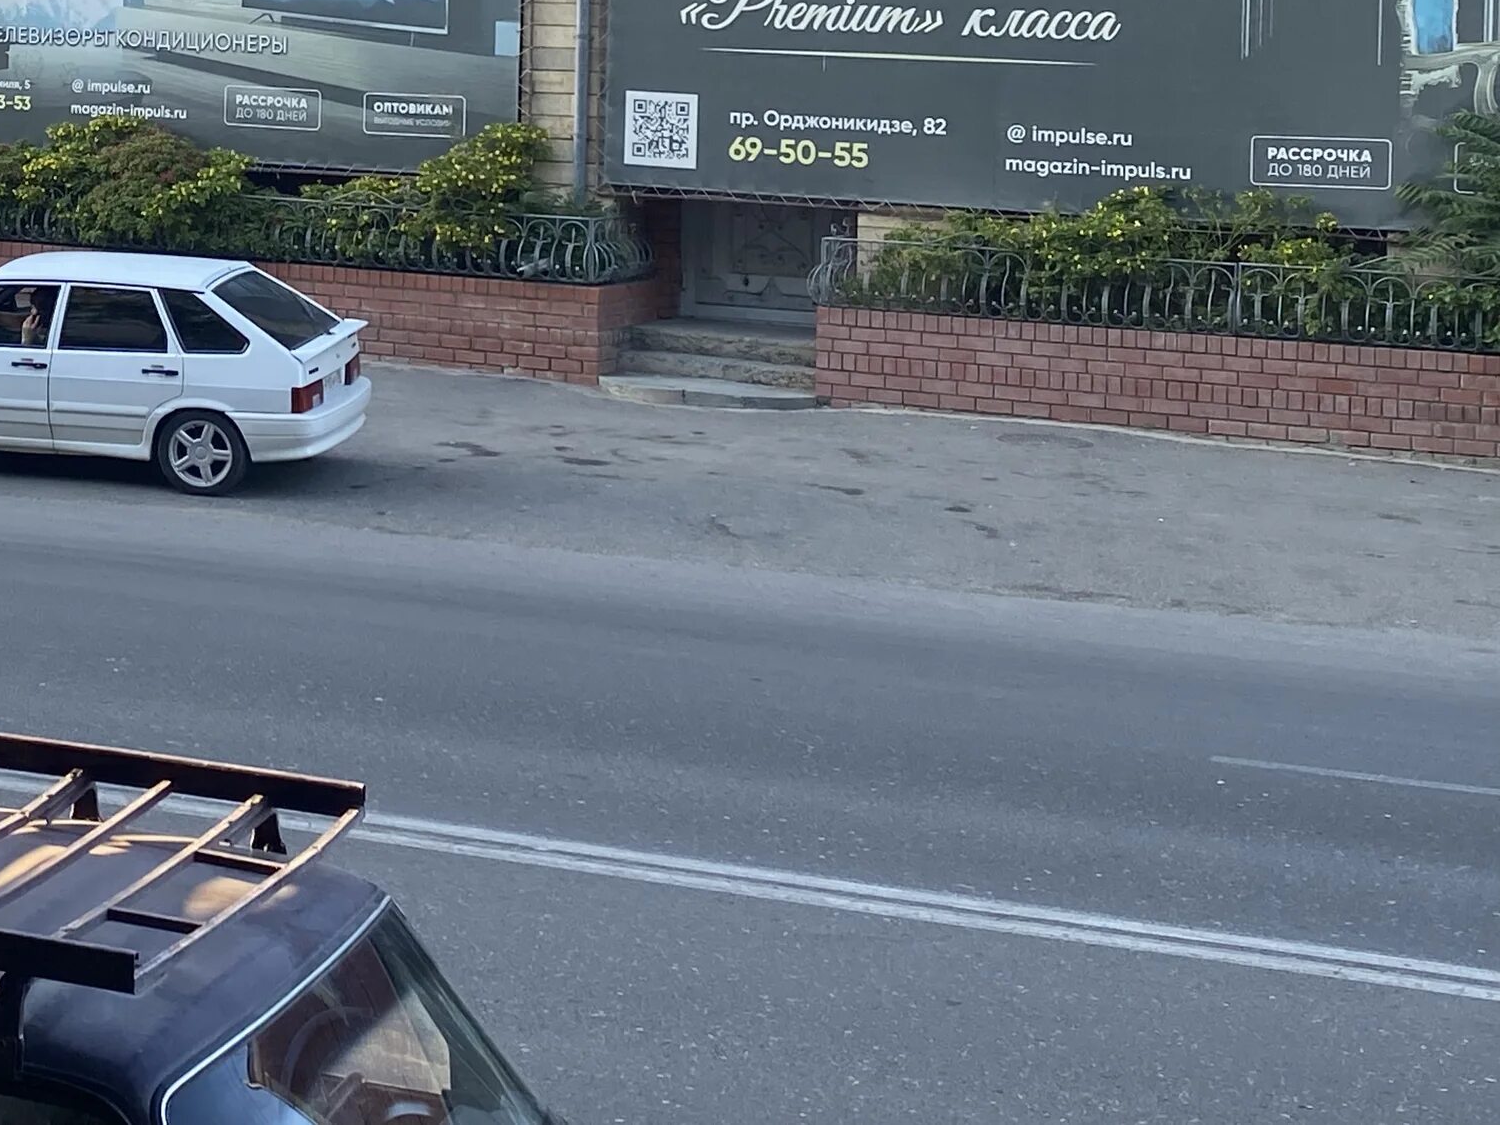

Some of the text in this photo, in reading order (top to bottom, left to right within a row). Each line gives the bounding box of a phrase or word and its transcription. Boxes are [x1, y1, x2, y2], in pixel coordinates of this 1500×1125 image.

[961, 7, 1121, 41] класса
[115, 30, 288, 55] КОНДИЦИОНЕРЫ
[24, 79, 31, 89] 5
[87, 79, 150, 95] impulse.ru
[235, 94, 308, 109] РАССРОЧКА
[374, 101, 453, 115] ОПТОВИКАМ
[70, 103, 187, 120] magazin-impuls.ru
[235, 108, 307, 122] ДО 180 ДНЕЙ
[729, 110, 947, 137] пр. Орджоникидзе, 82
[1032, 125, 1133, 147] impulse.ru
[728, 136, 869, 168] 69-50-55
[1267, 147, 1372, 162] РАССРОЧКА
[1005, 158, 1191, 181] magazin-impuls.ru
[1267, 163, 1371, 179] ДО 180 ДНЕЙ
